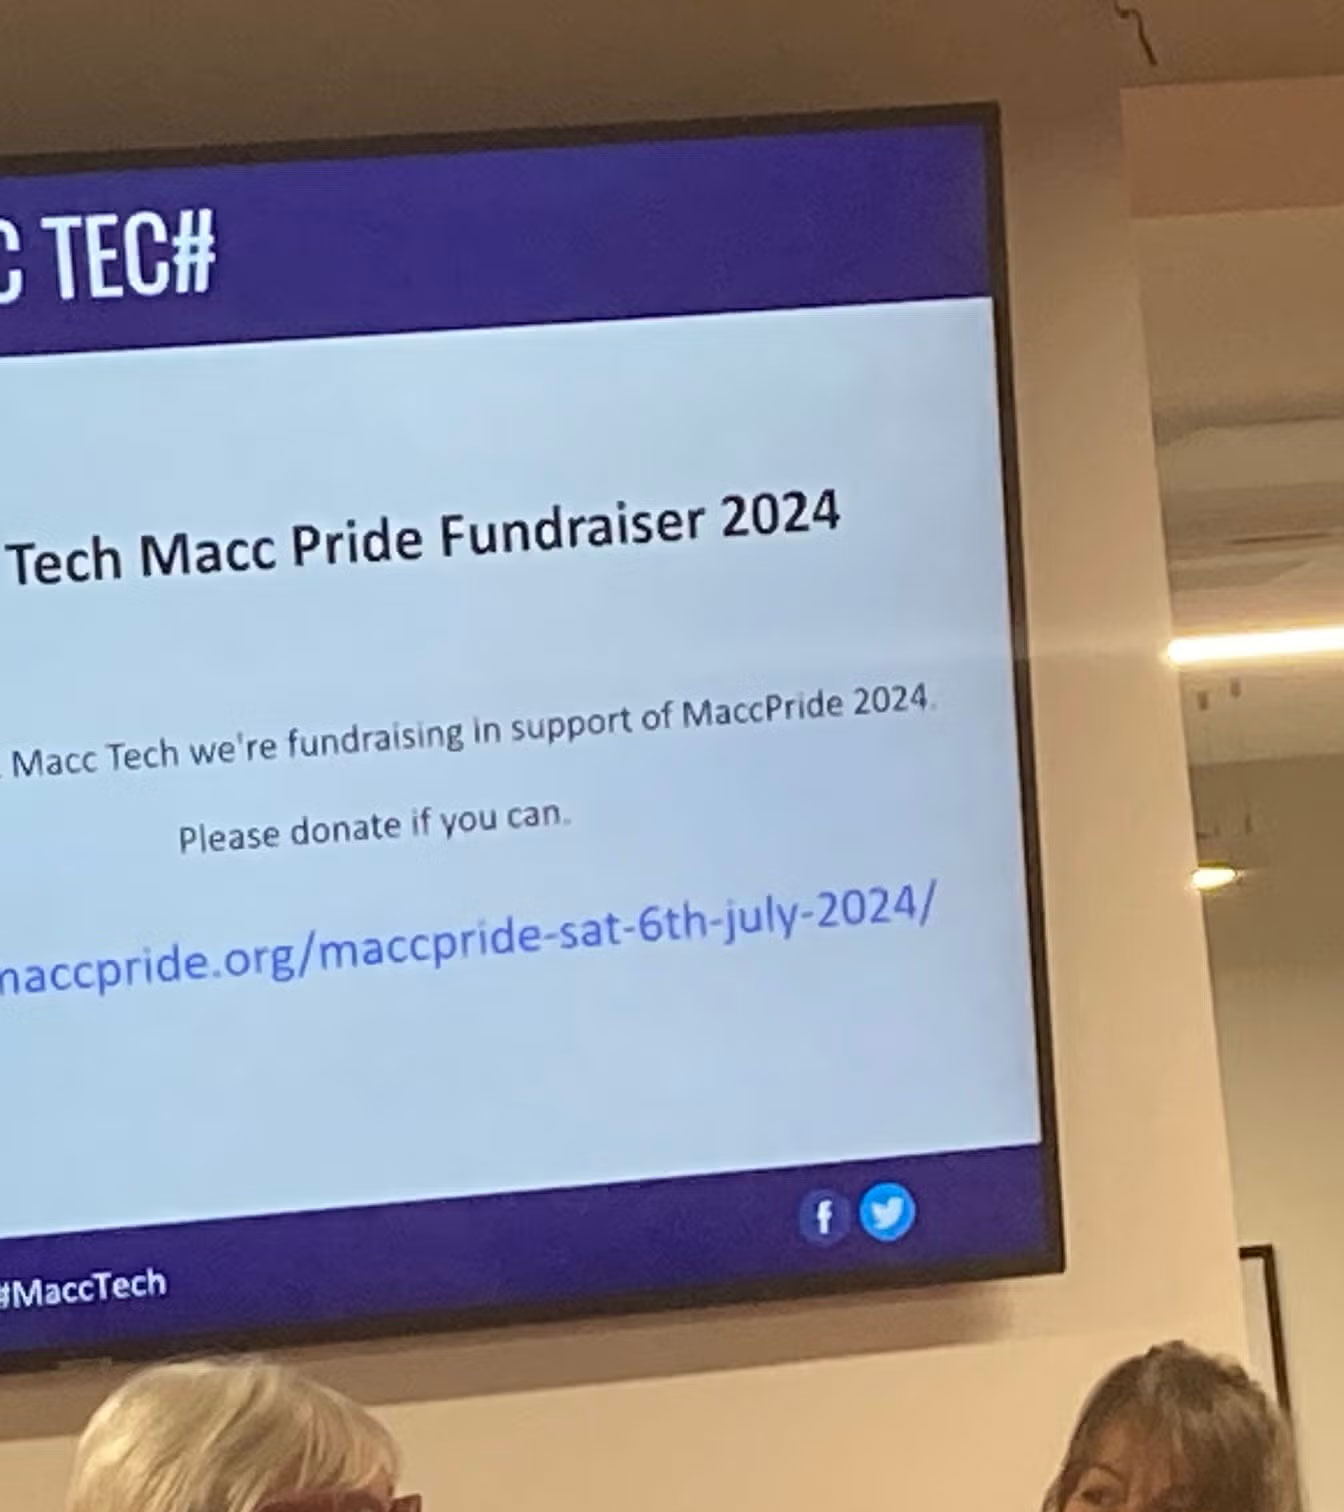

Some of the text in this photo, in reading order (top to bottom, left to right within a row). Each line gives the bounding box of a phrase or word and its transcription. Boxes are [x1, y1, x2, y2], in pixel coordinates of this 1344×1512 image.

[41, 208, 216, 300] TEC#
[5, 535, 122, 585] Tech
[140, 532, 276, 577] Macc
[292, 516, 422, 566] Pride
[441, 500, 705, 557] Fundraiser
[721, 488, 840, 537] 2024
[12, 747, 98, 779] Macc
[106, 738, 179, 771] Tech
[190, 731, 276, 766] we're
[288, 721, 464, 756] fundraising
[473, 716, 501, 744] in
[511, 706, 631, 744] support
[642, 699, 675, 731] of
[683, 690, 844, 728] MaccPride
[854, 682, 938, 716] 2024.
[179, 803, 572, 854] Please donate if you can.
